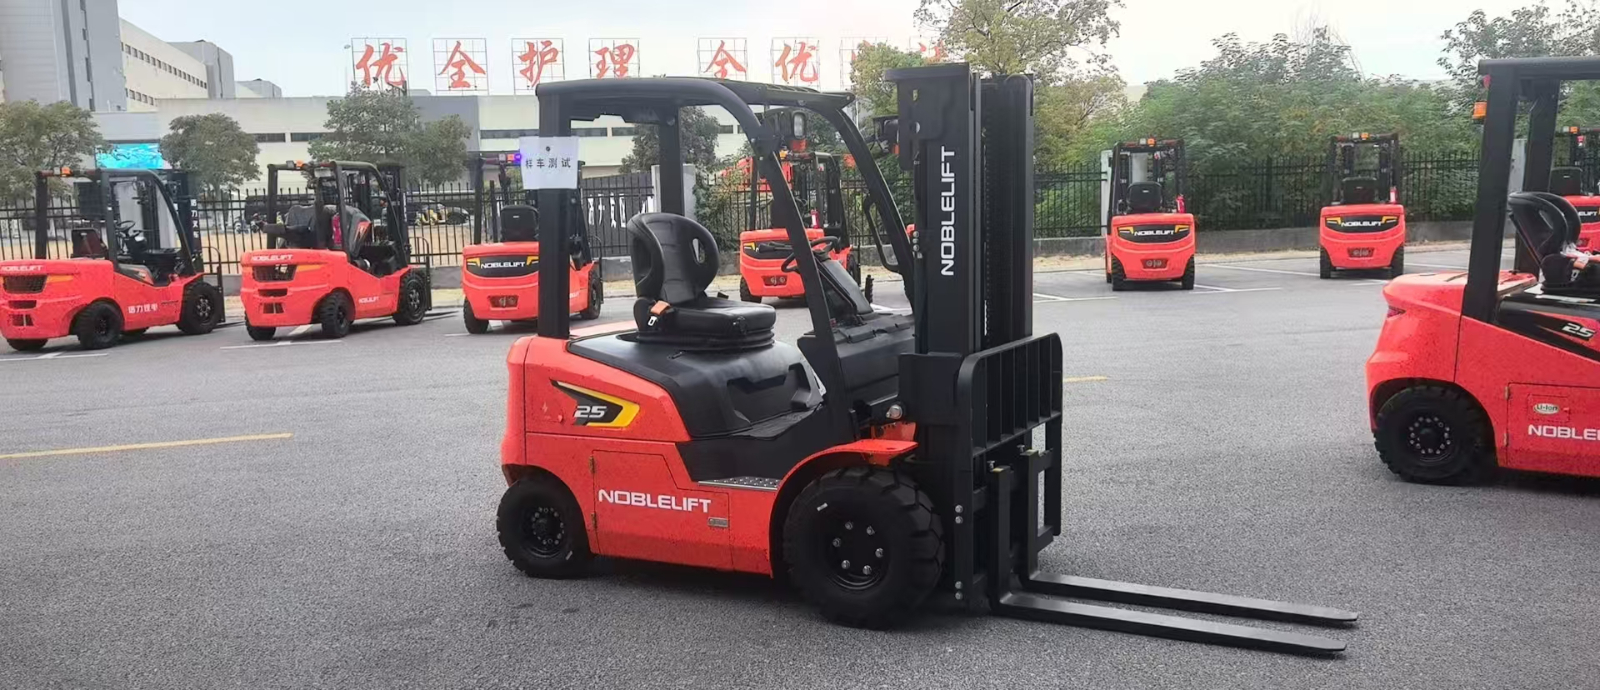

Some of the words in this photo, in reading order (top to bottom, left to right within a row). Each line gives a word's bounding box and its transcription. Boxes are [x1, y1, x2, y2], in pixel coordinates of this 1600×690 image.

[356, 40, 635, 88] 优全护理
[940, 146, 955, 276] NOBLELIFT
[480, 261, 526, 269] NOBLELIFT
[1562, 322, 1596, 338] 25
[574, 405, 607, 418] 25
[598, 489, 712, 513] NOBLELIFT
